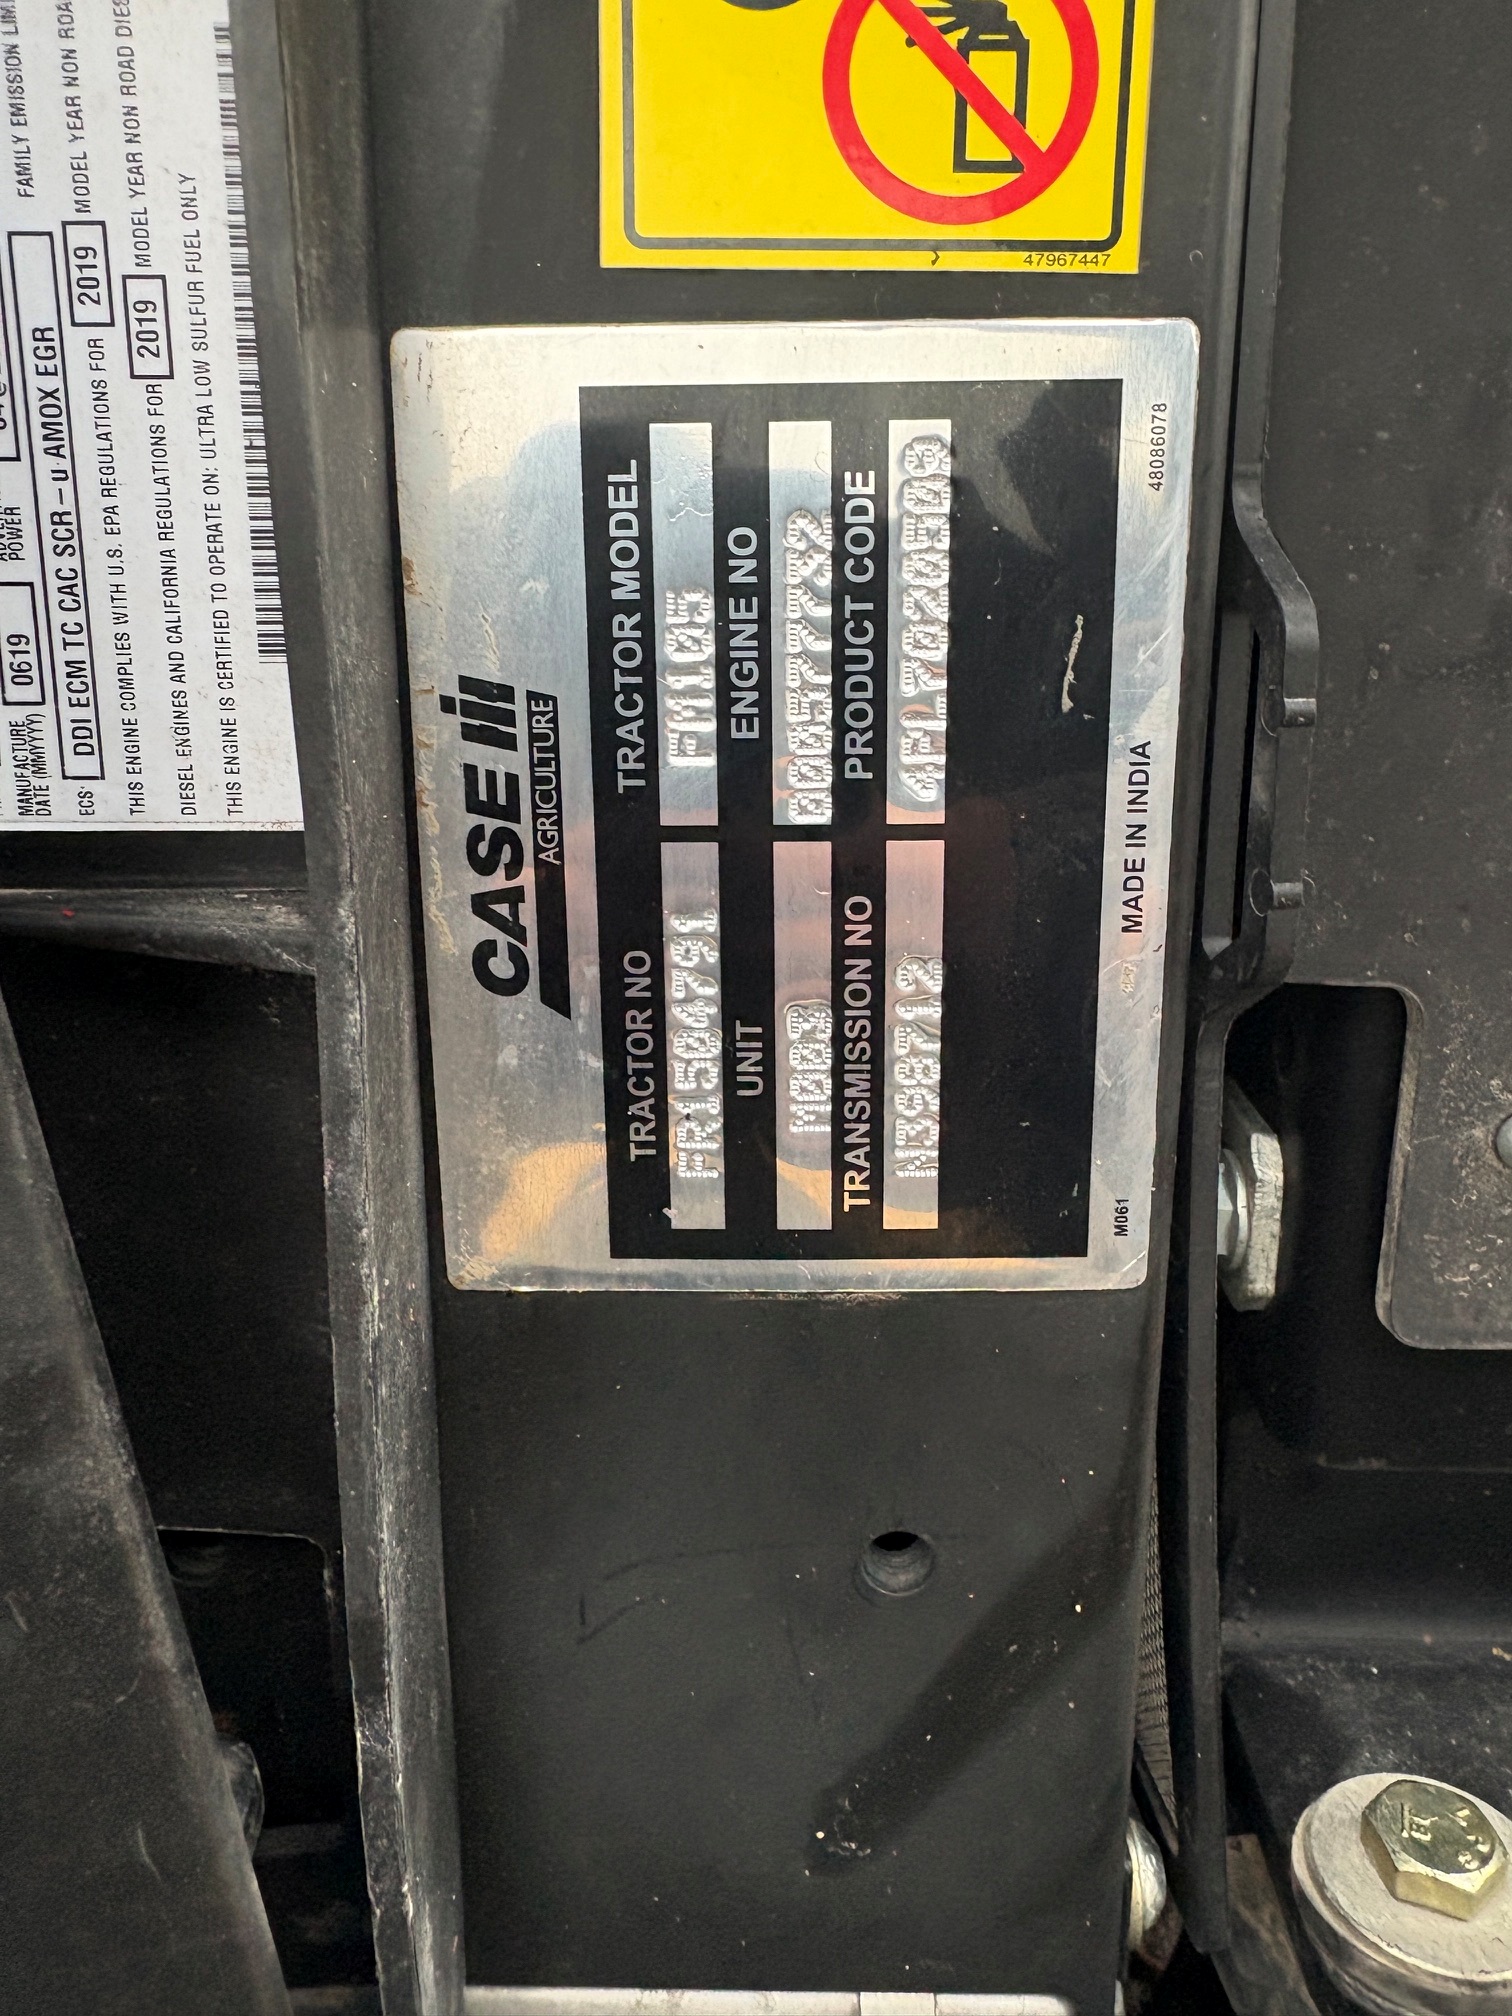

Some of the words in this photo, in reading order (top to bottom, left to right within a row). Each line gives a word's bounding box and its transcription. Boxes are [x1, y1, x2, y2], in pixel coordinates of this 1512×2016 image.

[55, 0, 75, 40] ROA
[2, 44, 27, 126] EMISSION
[60, 49, 79, 87] NON
[117, 46, 137, 96] ROAD
[65, 96, 84, 143] YEAR
[122, 106, 141, 143] NON
[11, 135, 35, 197] FAMILY
[70, 151, 91, 213] MODEL
[126, 152, 145, 199] YEAR
[178, 173, 198, 220] ONLY
[131, 207, 151, 267] MODEL
[183, 229, 202, 273] FUEL
[1023, 253, 1111, 267] 47967447
[74, 247, 101, 305] 2019
[133, 301, 160, 358] 2019
[187, 282, 208, 351] SULFUR
[32, 327, 58, 376] EGR
[88, 339, 106, 371] FOR
[192, 360, 212, 396] LOW
[37, 387, 66, 459] AMOX
[146, 384, 164, 416] FOR
[93, 379, 117, 497] REGULATIONS
[196, 405, 216, 458] ULTRA
[1148, 402, 1168, 492] 48086078
[149, 425, 174, 541] REGULATIONS
[202, 468, 219, 495] ON:
[8, 506, 26, 561] POWER
[103, 505, 121, 535] EPA
[202, 503, 225, 576] OPERATE
[607, 459, 640, 600] MODEL
[844, 470, 875, 584] CODE
[106, 544, 124, 575] U.S.
[727, 526, 759, 584] NO
[55, 568, 81, 611] CAC
[109, 584, 129, 625] WITH
[160, 549, 182, 643] CALIFORNIA
[210, 583, 227, 603] TO
[9, 633, 35, 686] 0619
[61, 622, 84, 651] TC
[213, 610, 234, 689] CERTIFIED
[65, 660, 90, 707] ECM
[114, 633, 136, 711] COMPLIES
[168, 651, 186, 683] AND
[728, 596, 760, 740] ENGINE
[844, 595, 875, 780] PRODUCT
[170, 690, 192, 756] ENGINES
[219, 697, 236, 710] IS
[612, 612, 646, 794] TRACTOR
[70, 719, 95, 755] DDI
[122, 718, 142, 774] ENGINE
[220, 718, 240, 774] ENGINE
[8, 719, 30, 816] MANUFACTURE
[177, 764, 197, 815] DIESEL
[531, 699, 562, 865] AGRICULTURE
[1127, 740, 1151, 819] INDIA
[34, 784, 52, 817] DATE
[128, 782, 145, 815] THIS
[226, 782, 243, 816] THIS
[1125, 822, 1147, 849] IN
[463, 762, 531, 997] CASE
[1121, 855, 1146, 935] MADE
[844, 895, 873, 947] NO
[624, 950, 652, 999] NO
[625, 1008, 657, 1162] TRACTOR
[736, 1020, 764, 1098] UNIT
[844, 957, 873, 1212] TRANSMISSION
[1113, 1198, 1129, 1236] M061
